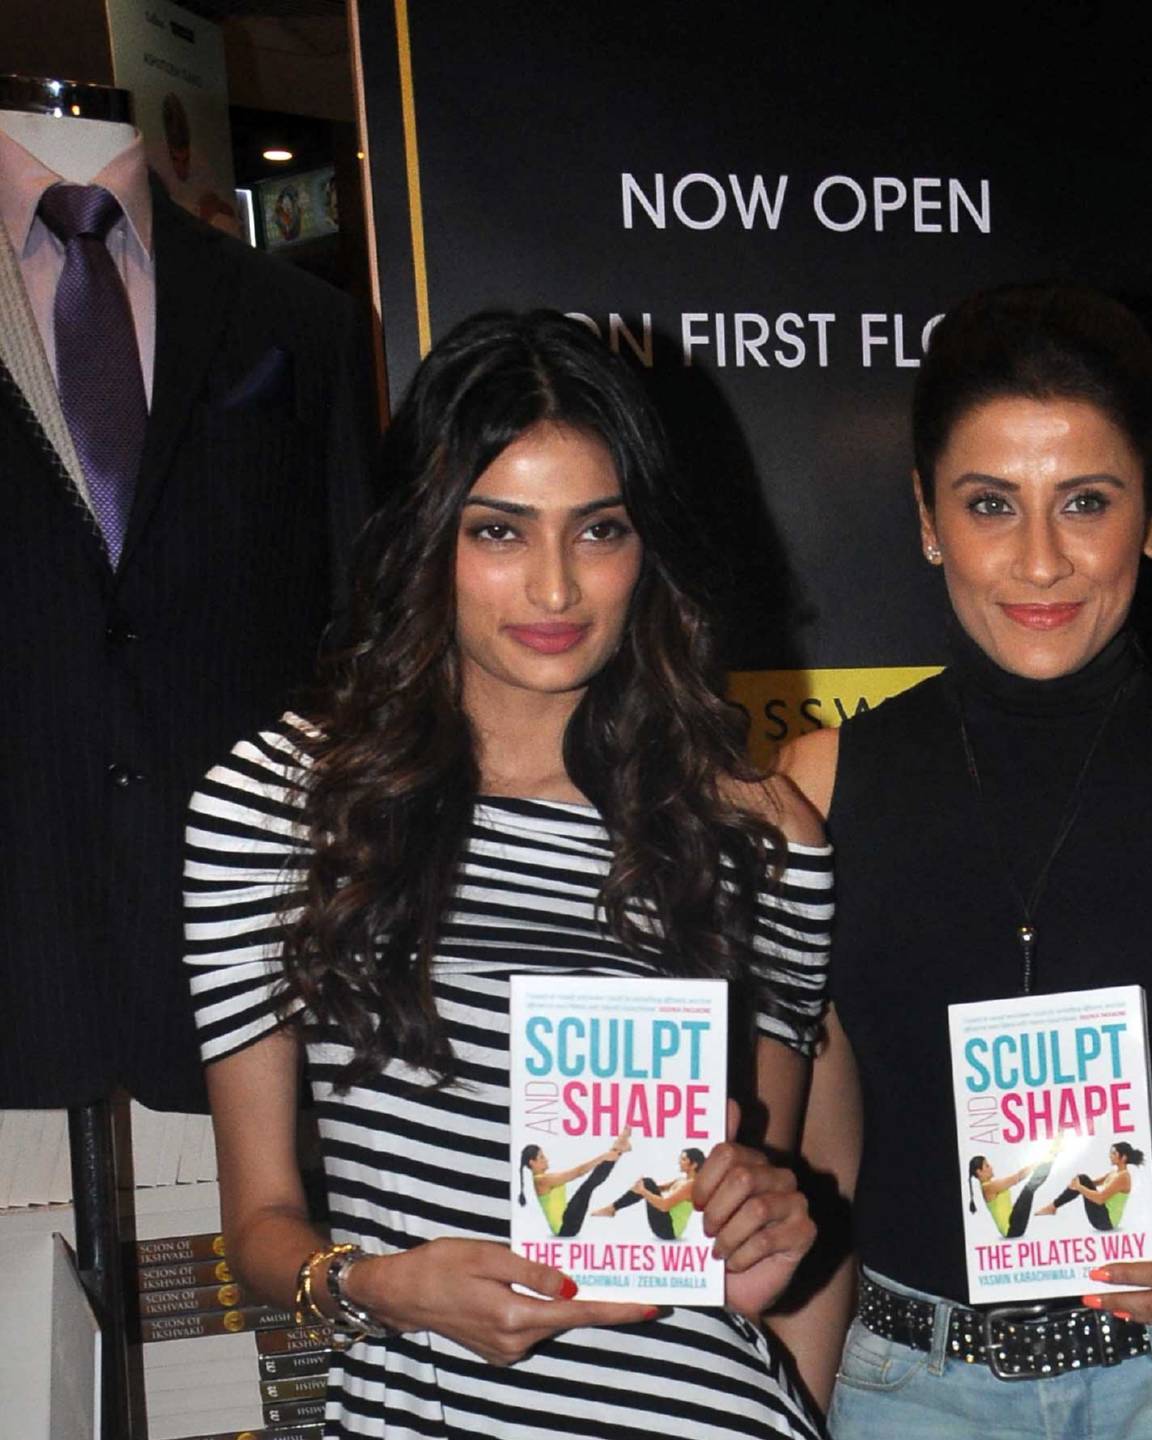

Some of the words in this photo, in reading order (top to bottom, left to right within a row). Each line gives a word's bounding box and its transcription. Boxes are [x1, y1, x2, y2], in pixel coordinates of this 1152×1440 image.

[622, 172, 788, 231] NOW
[813, 175, 991, 234] OPEN
[681, 312, 837, 369] FIRST
[525, 1016, 711, 1080] SCULPT
[964, 1023, 1128, 1093] SCULPT
[525, 1081, 559, 1135] AND
[562, 1080, 710, 1139] SHAPE
[967, 1095, 1000, 1145] AND
[1001, 1082, 1136, 1144] SHAPE
[522, 1242, 563, 1269] THE
[569, 1243, 655, 1271] PILATES
[661, 1245, 710, 1272] WAY
[975, 1245, 1013, 1271] THE
[1017, 1237, 1097, 1268] PILATES
[1100, 1232, 1147, 1260] WAY
[259, 1314, 291, 1324] AMISH
